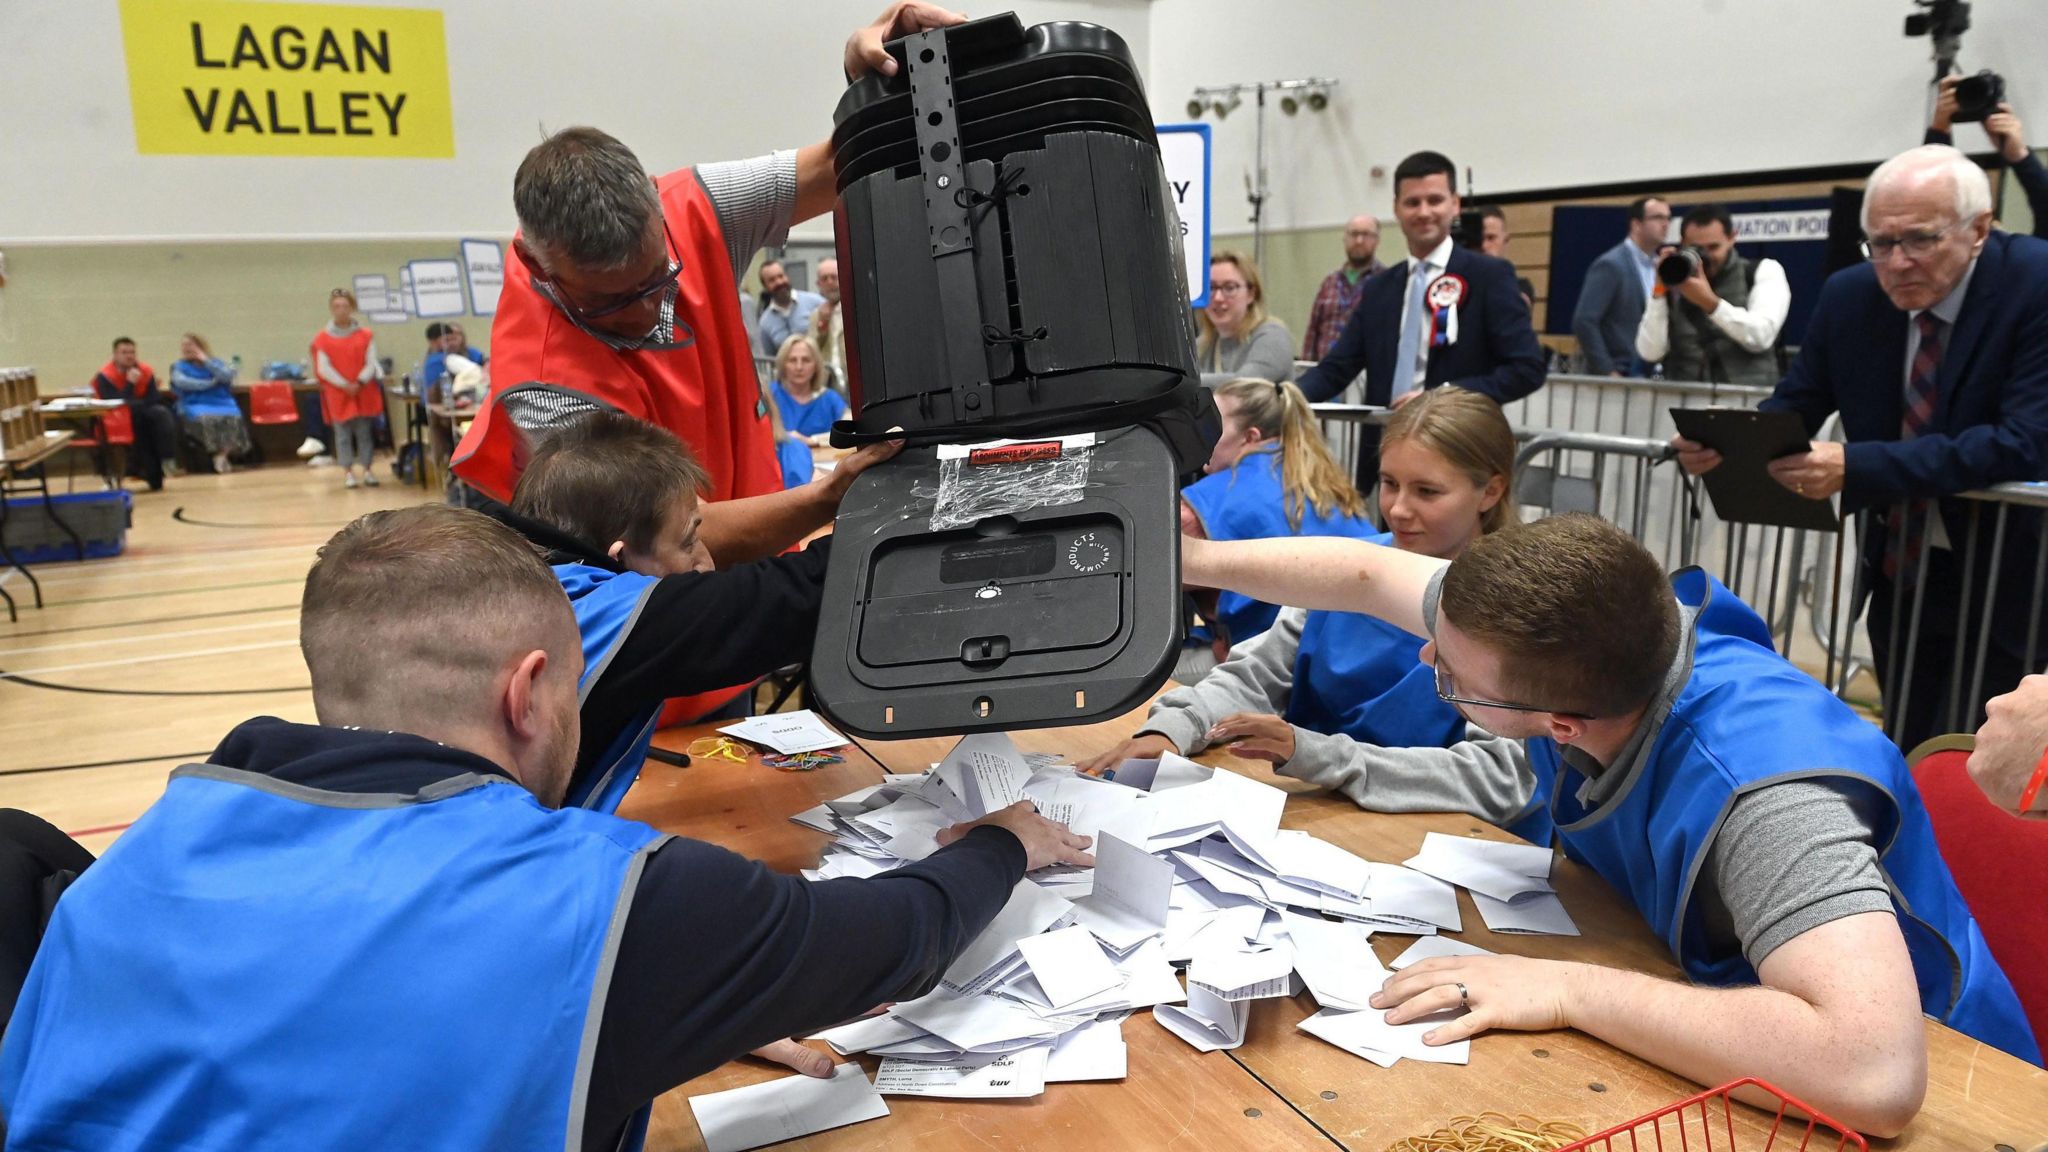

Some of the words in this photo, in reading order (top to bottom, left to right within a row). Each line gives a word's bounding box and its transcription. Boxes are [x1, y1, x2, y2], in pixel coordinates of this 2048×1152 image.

[191, 22, 391, 74] LAGAN
[183, 87, 406, 137] VALLEY
[1069, 532, 1095, 572] PRODUCTS
[1088, 542, 1110, 572] MILLENNIUM
